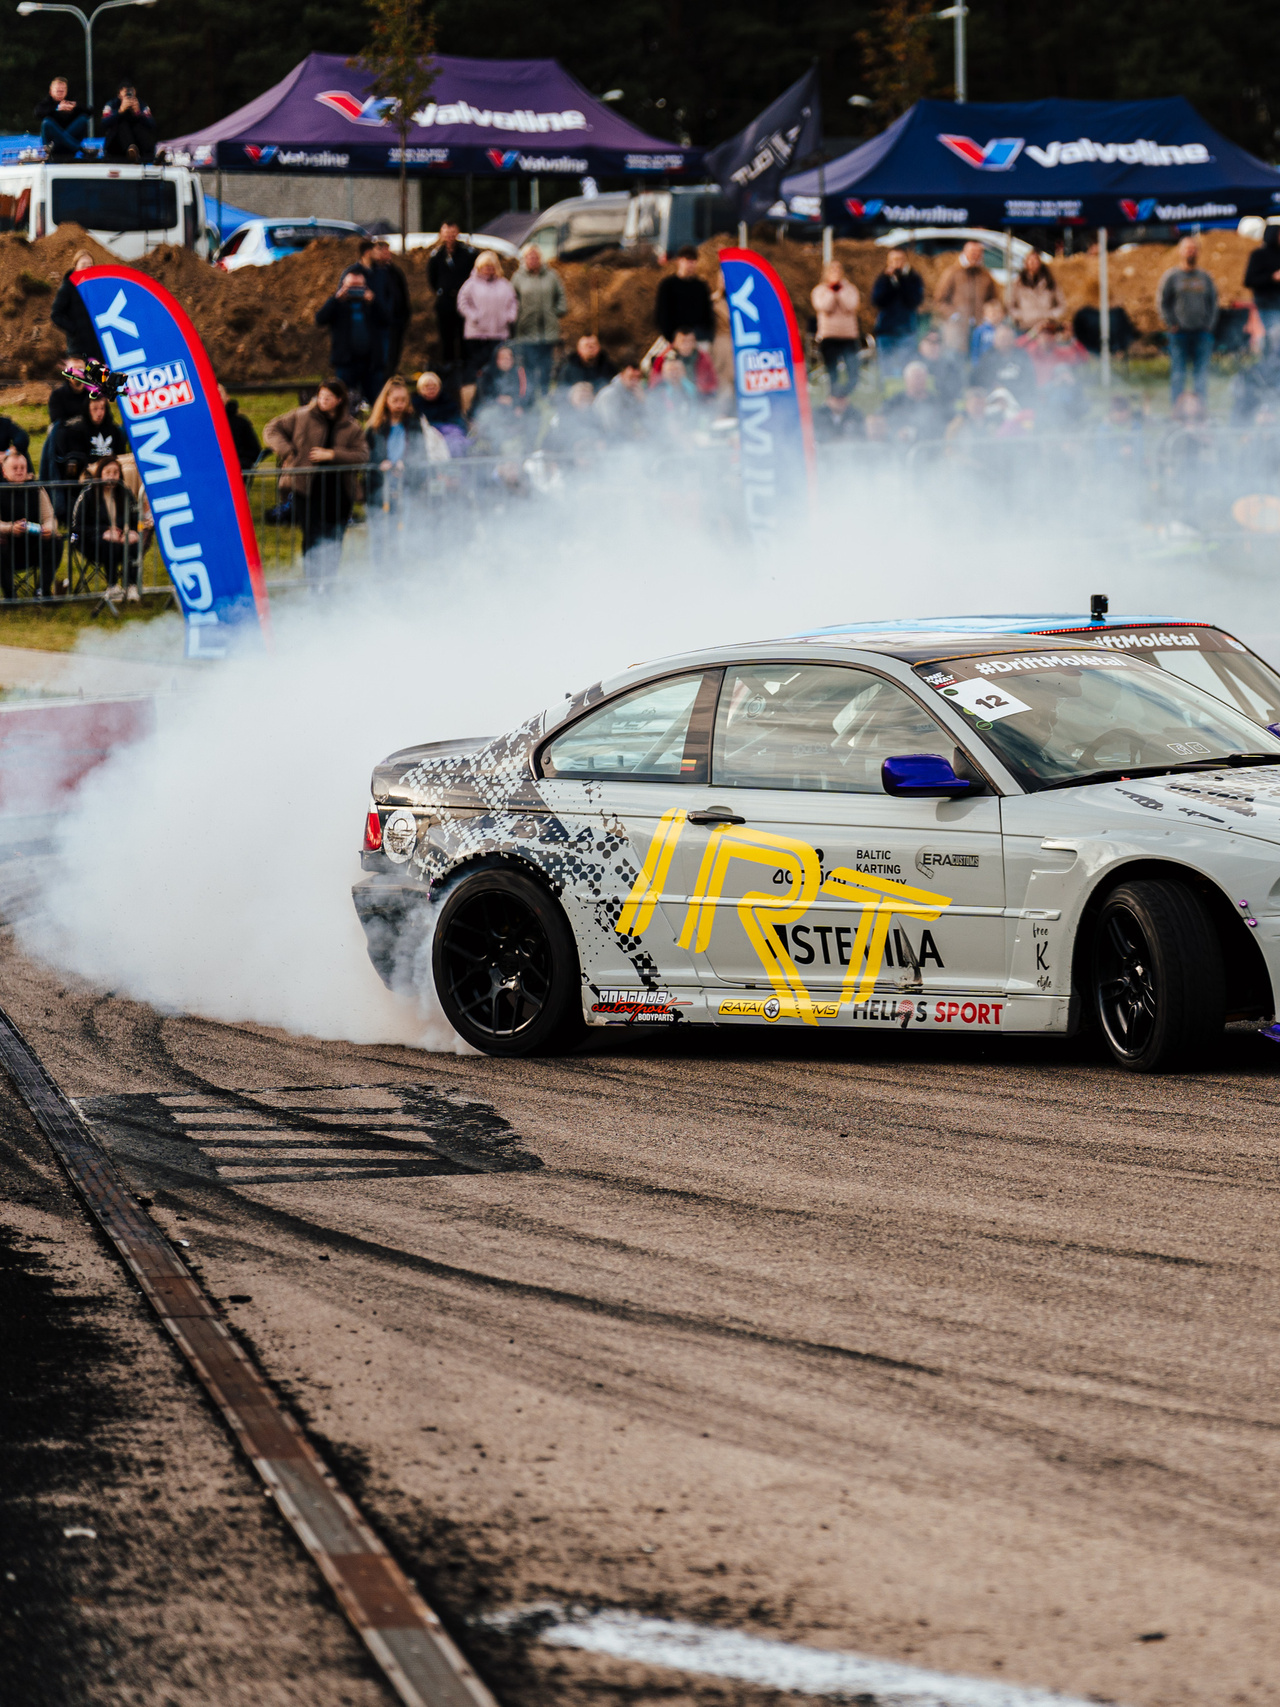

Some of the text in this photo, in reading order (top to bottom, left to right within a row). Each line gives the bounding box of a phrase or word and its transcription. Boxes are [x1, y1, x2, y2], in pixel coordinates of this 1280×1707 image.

[410, 100, 588, 133] Valvoline
[1025, 138, 1212, 168] Valvoline
[974, 655, 1128, 675] #DriftMolėtai
[930, 675, 955, 685] WAY
[975, 694, 1010, 710] 12
[856, 849, 892, 860] BALTIC
[922, 853, 979, 867] ERA CUSTOMS
[856, 864, 901, 875] KARTING
[615, 807, 953, 1026] IRT
[1033, 922, 1049, 938] free
[1036, 940, 1051, 971] K
[591, 997, 693, 1022] autosport
[721, 1003, 762, 1013] RATAI
[934, 1001, 1003, 1025] SPORT
[637, 1013, 674, 1022] BODYPARTS
